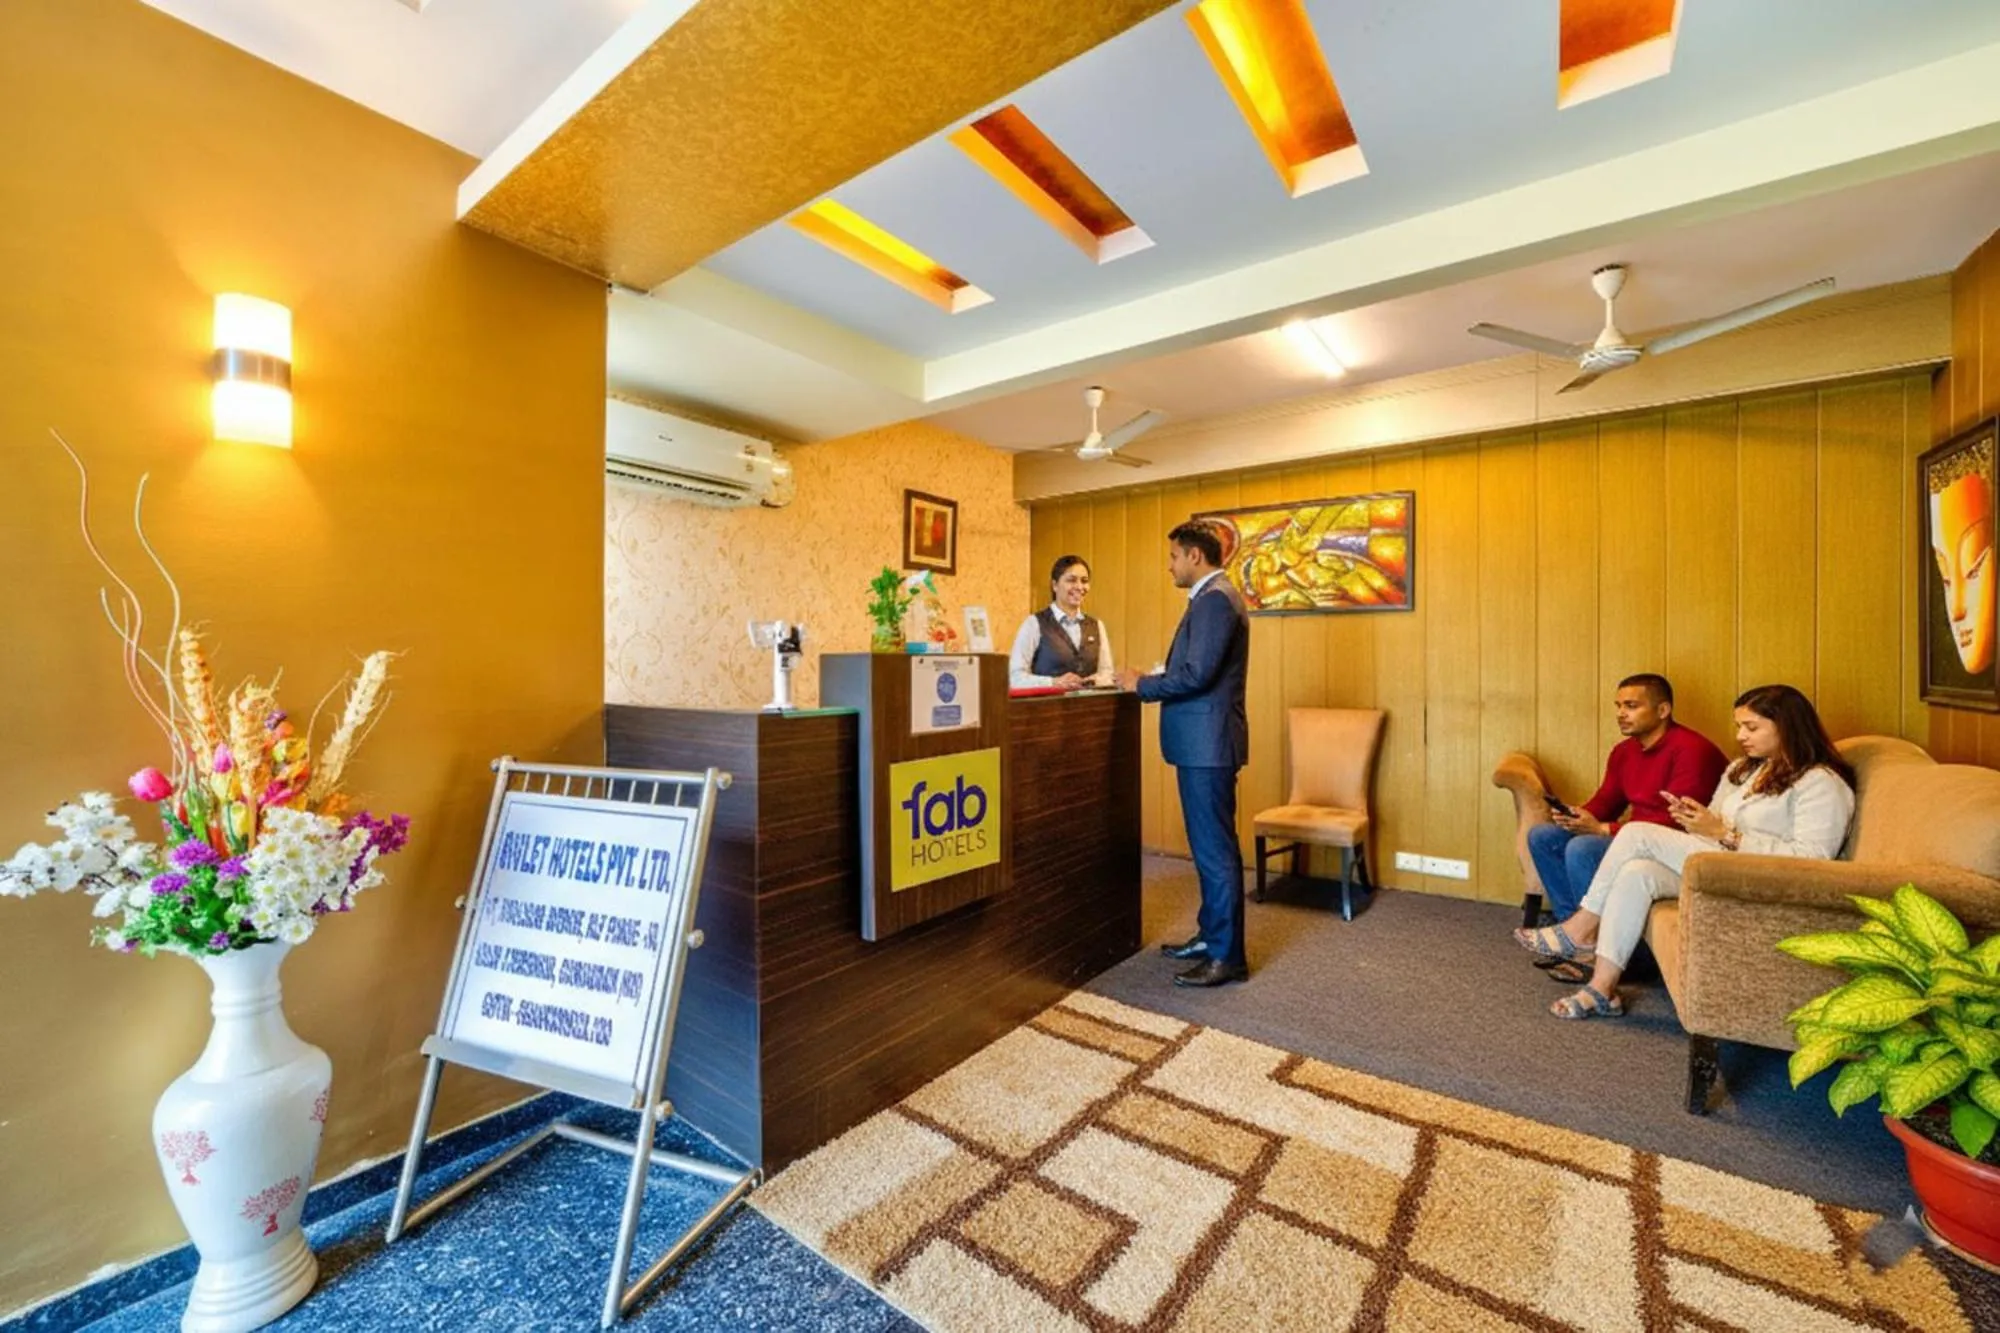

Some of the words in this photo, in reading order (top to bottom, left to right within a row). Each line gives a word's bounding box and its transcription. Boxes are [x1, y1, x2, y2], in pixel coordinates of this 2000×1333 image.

[901, 775, 987, 840] fab
[549, 837, 607, 883] HOTELS
[911, 829, 987, 867] HOTELS
